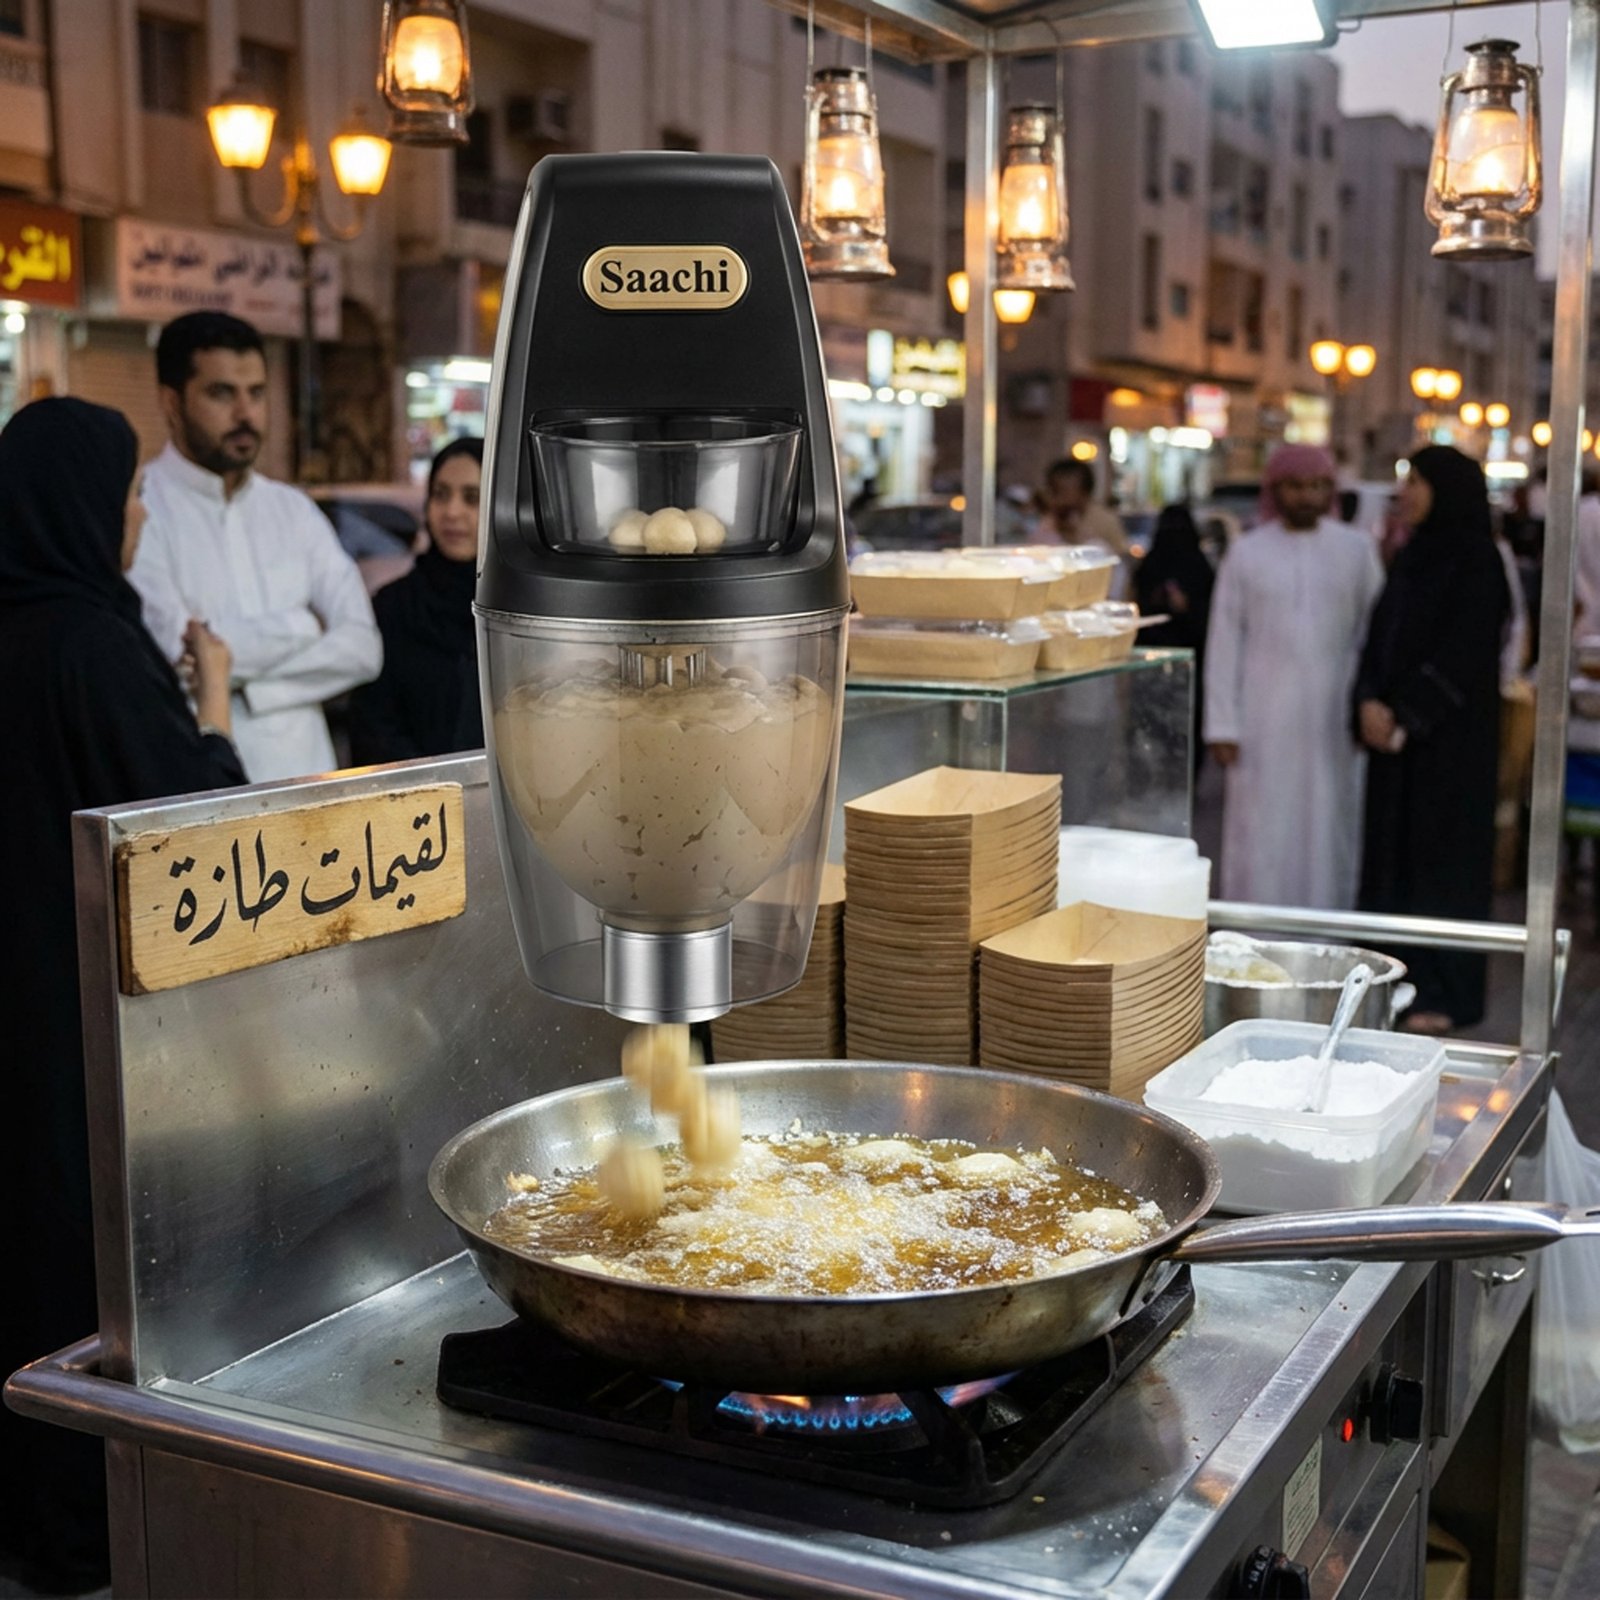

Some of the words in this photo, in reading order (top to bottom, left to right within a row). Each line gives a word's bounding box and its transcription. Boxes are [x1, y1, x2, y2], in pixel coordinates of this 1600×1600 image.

[600, 260, 730, 293] Saachi
[169, 829, 290, 946] طازة
[301, 803, 448, 915] لقيمات
